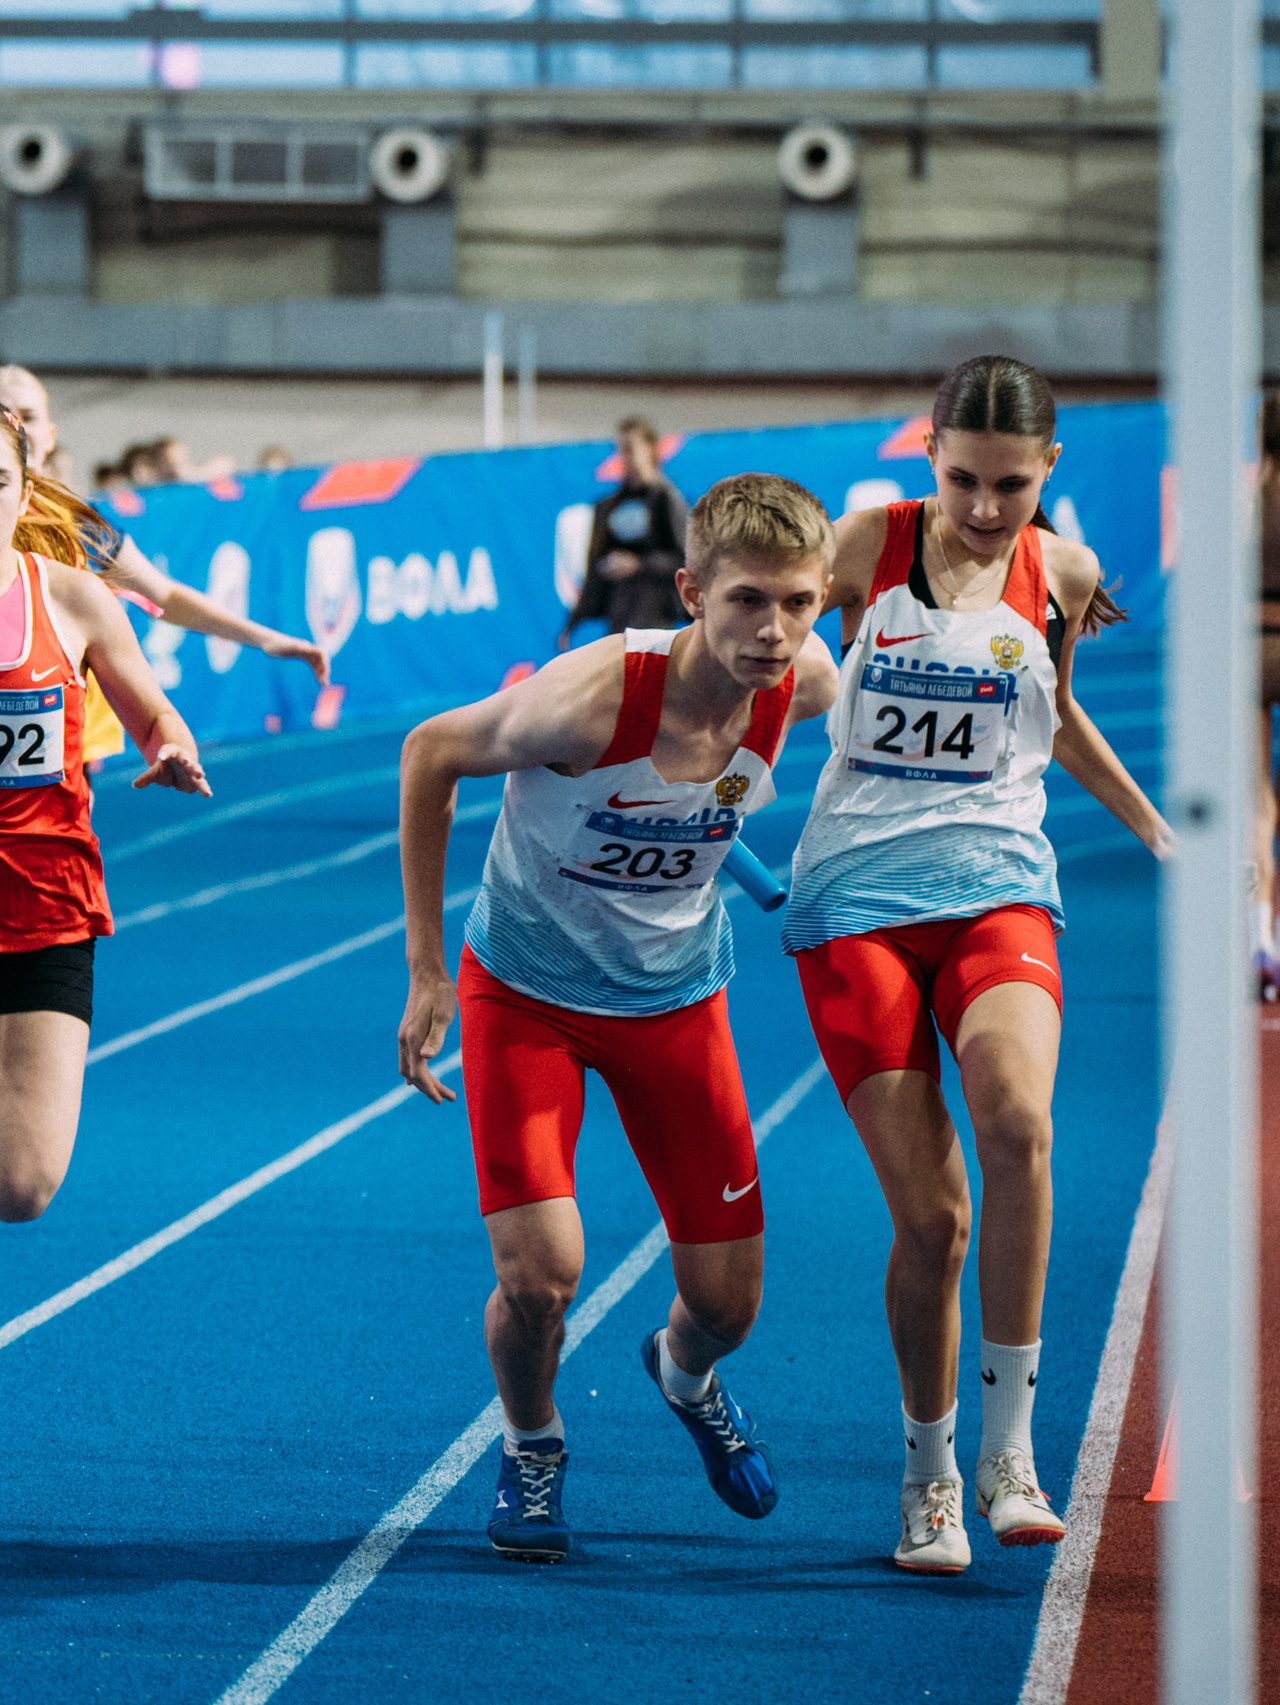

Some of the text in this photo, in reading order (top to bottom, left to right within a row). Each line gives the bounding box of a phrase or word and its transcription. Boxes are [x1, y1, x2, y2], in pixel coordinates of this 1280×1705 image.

[367, 547, 498, 625] ВФЛА
[890, 679, 926, 693] ТАТЬЯНЫ
[927, 684, 973, 698] ЛЕБЕДЕВОЙ
[873, 705, 975, 759] 214
[905, 770, 937, 780] ВФЛА
[590, 843, 696, 879] 203
